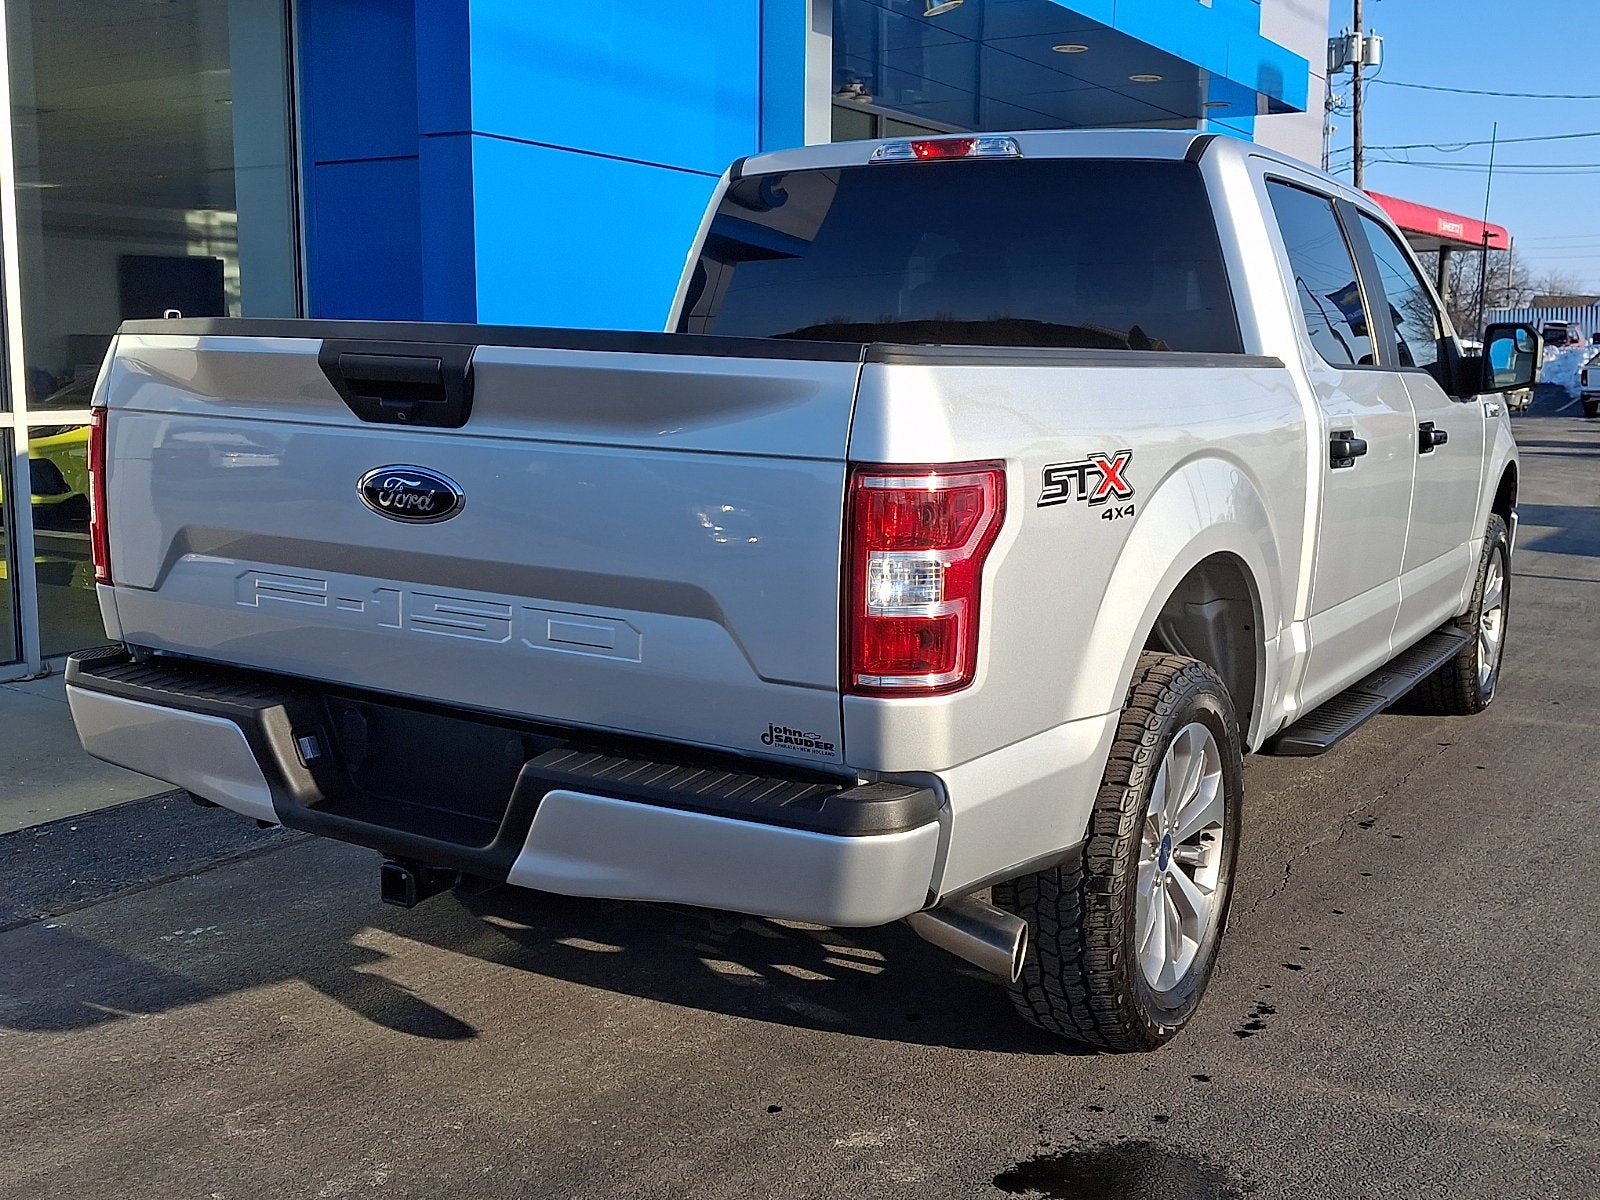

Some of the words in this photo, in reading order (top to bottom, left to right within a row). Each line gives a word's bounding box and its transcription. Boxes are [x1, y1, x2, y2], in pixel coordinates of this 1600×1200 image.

[378, 476, 436, 511] Ford
[1037, 449, 1135, 508] STX
[235, 569, 642, 664] F-150
[774, 734, 835, 751] SAUDER
